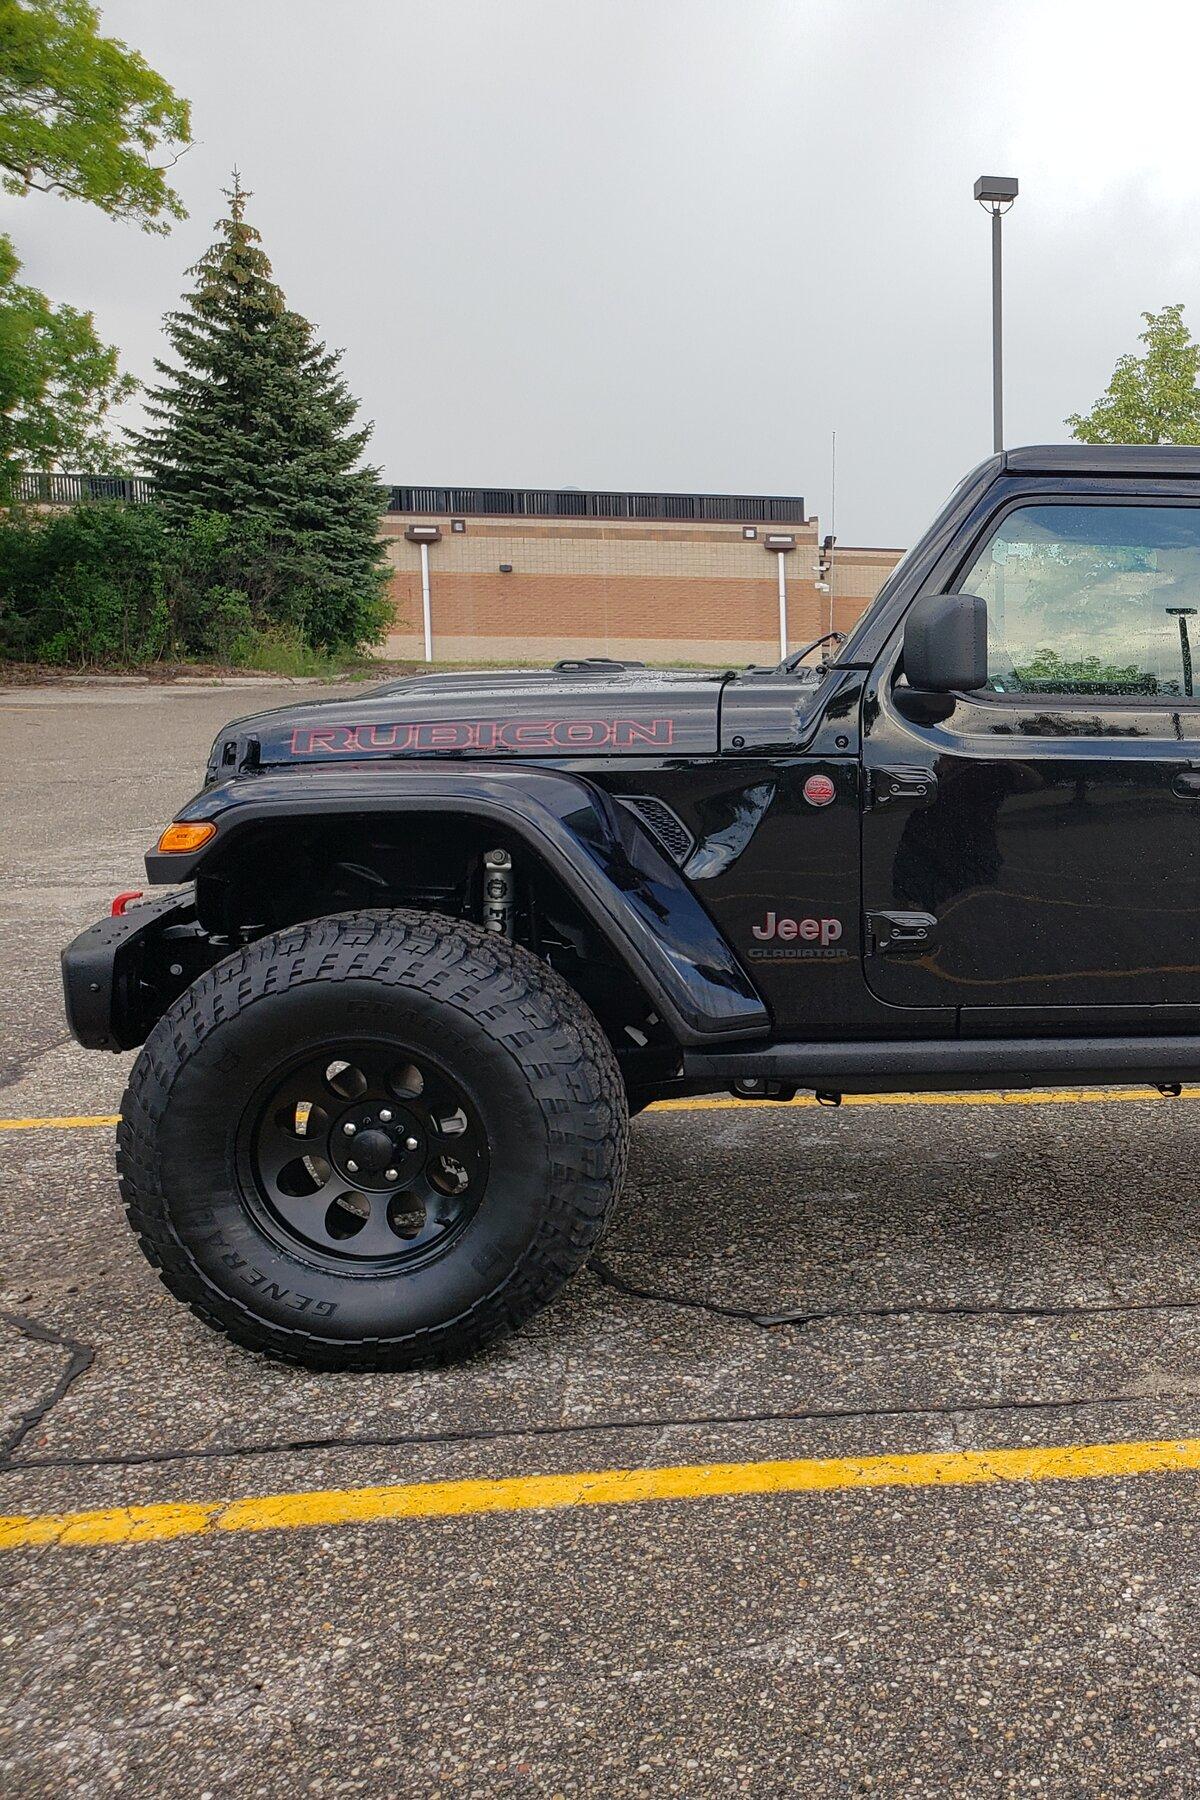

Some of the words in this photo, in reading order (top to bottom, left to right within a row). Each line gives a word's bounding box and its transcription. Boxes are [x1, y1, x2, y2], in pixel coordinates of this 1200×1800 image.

[290, 719, 674, 754] RUBICON
[485, 907, 508, 936] FO
[751, 911, 843, 946] Jeep
[747, 947, 849, 959] GLADIATOR
